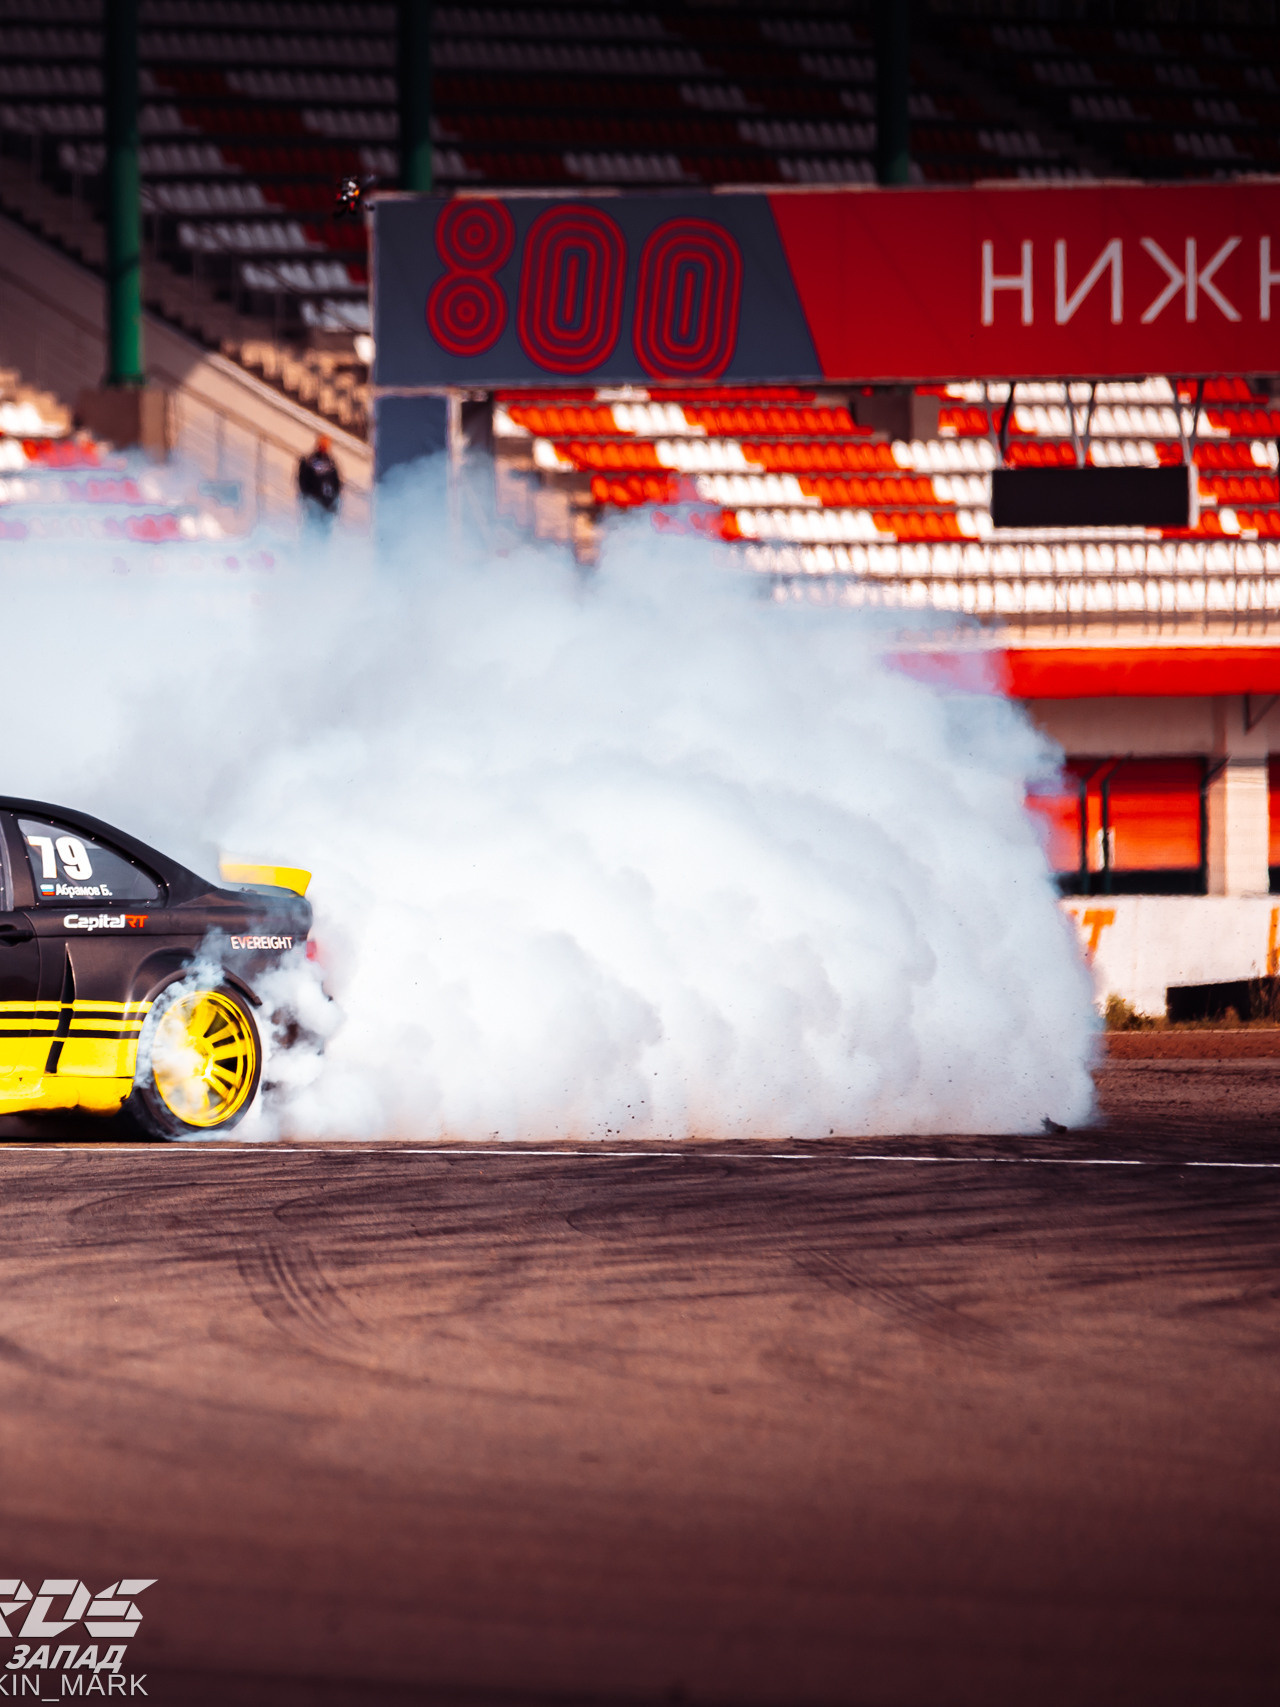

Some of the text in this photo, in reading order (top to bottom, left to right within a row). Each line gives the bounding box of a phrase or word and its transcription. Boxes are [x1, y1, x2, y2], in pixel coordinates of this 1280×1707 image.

[426, 197, 744, 381] 800
[27, 836, 93, 880] 79
[55, 884, 113, 898] Абрамов Б.
[230, 936, 293, 950] EVEREIGHT
